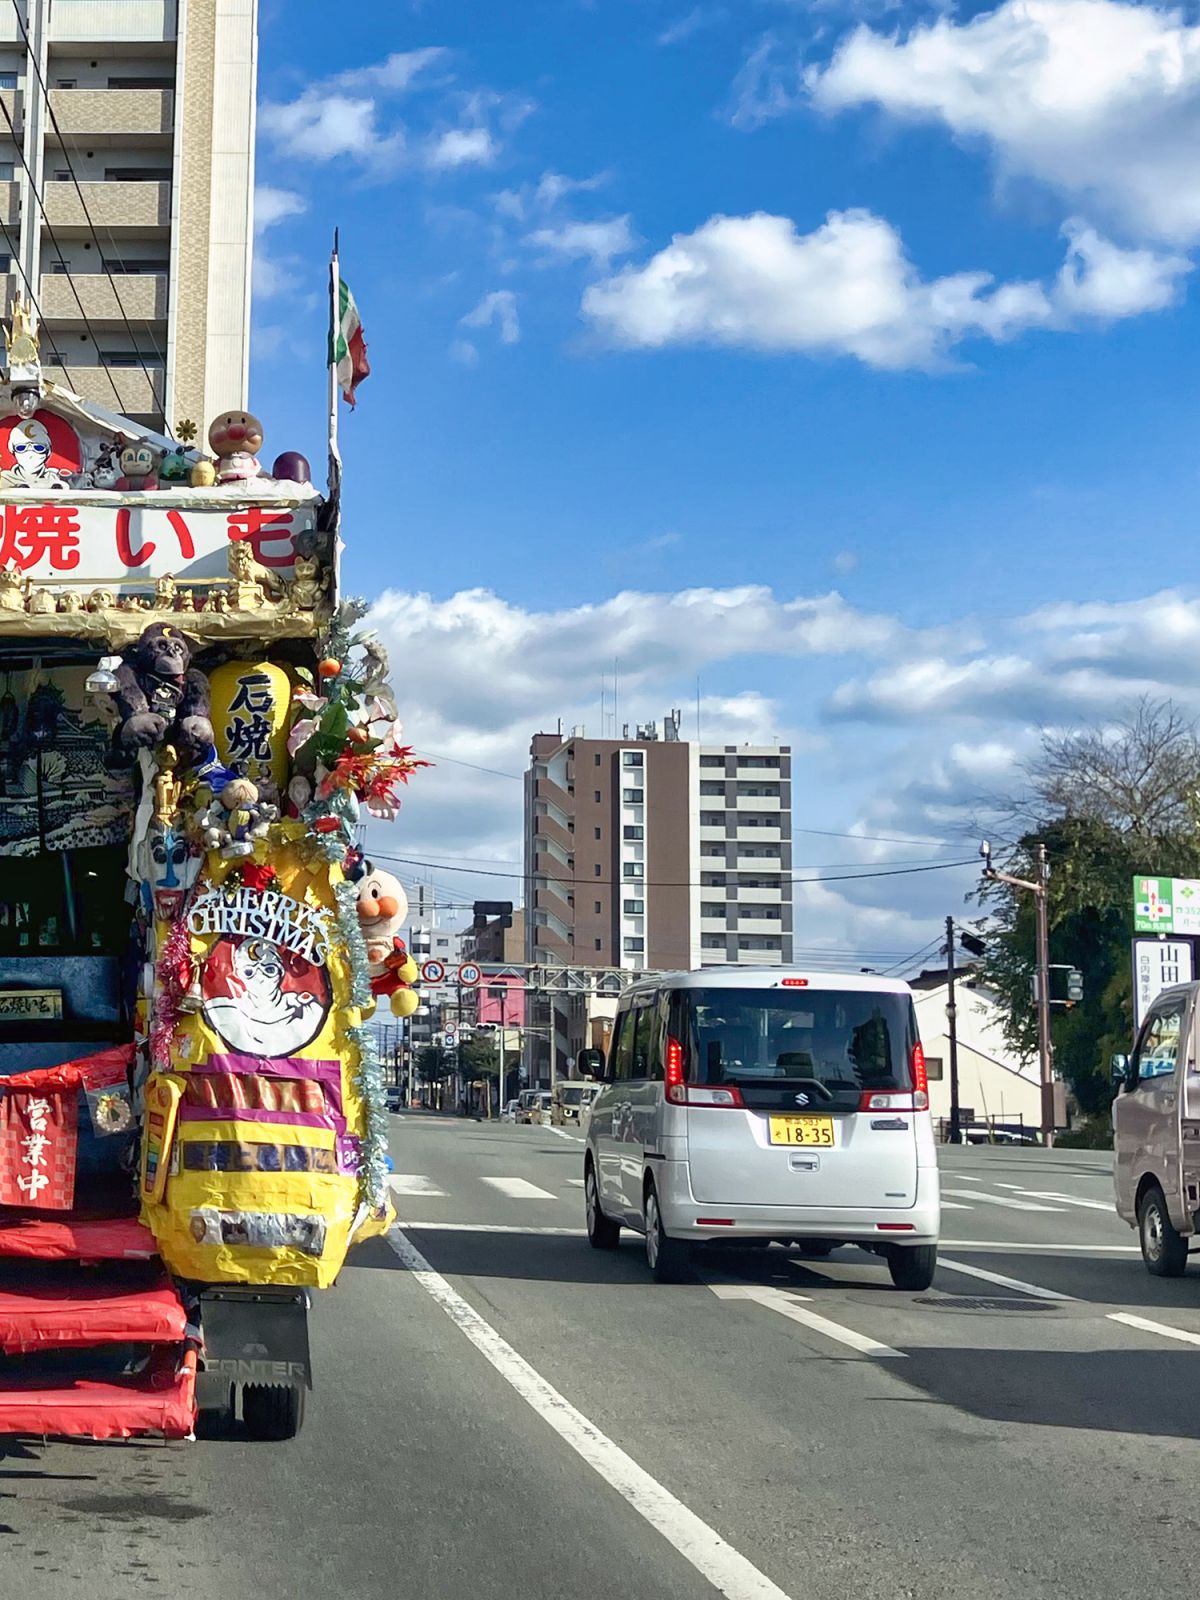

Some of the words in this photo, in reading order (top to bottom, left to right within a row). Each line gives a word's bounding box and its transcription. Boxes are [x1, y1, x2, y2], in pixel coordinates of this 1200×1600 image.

[218, 886, 313, 932] MERRY
[187, 908, 330, 967] CHRISTMAS
[463, 969, 476, 980] 40
[1160, 945, 1179, 990] 山田
[17, 1098, 53, 1200] 営業中
[786, 1127, 831, 1143] 18-35
[205, 1359, 305, 1377] CANTER
